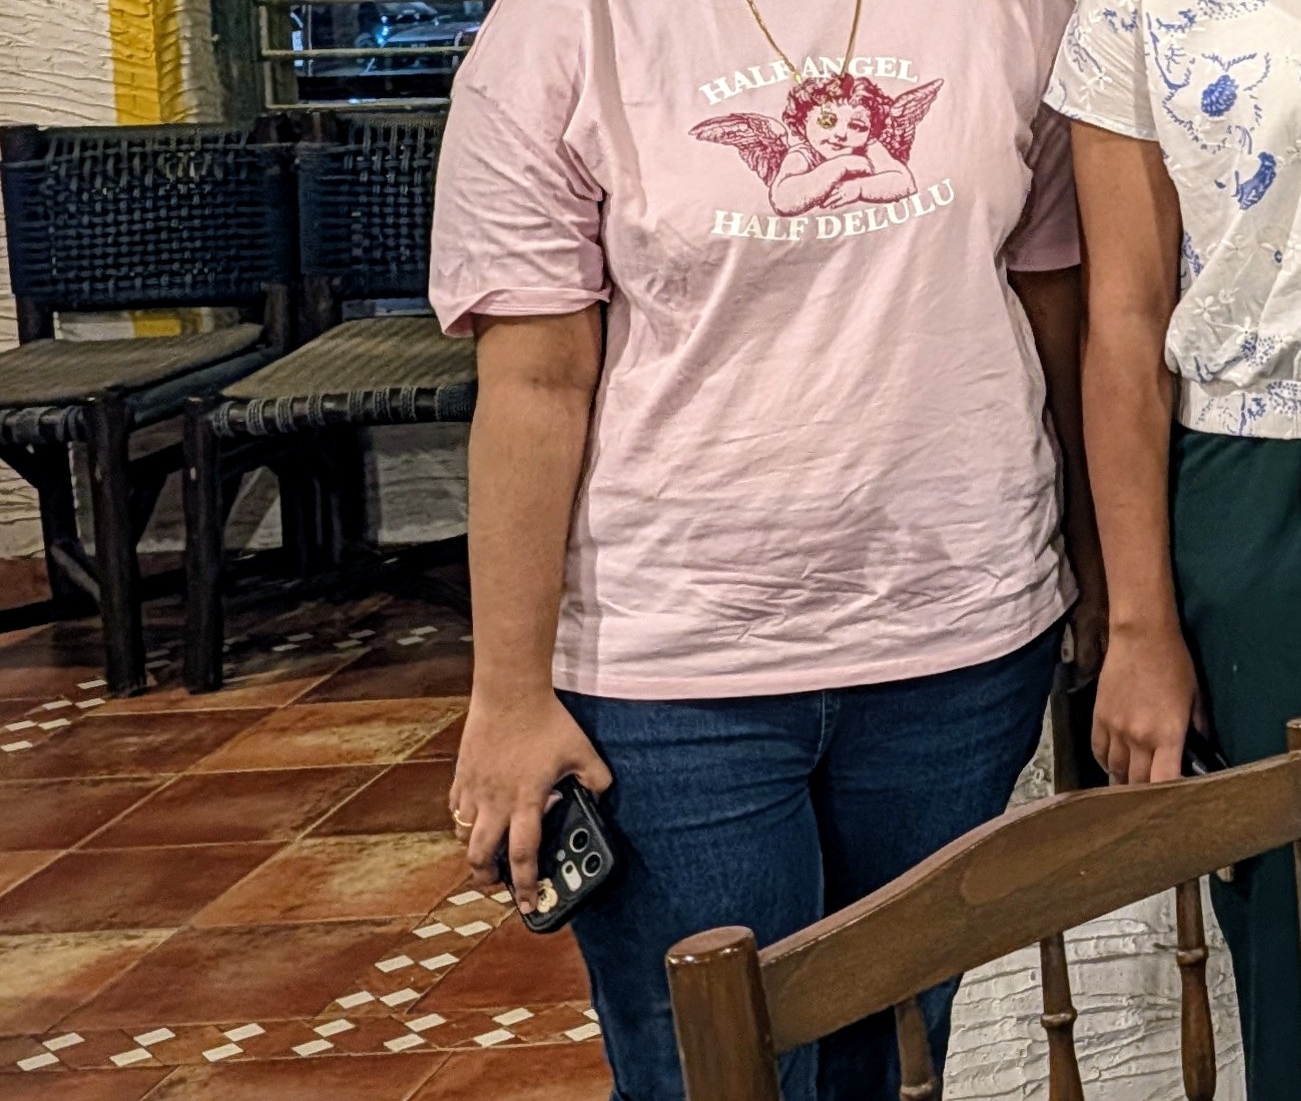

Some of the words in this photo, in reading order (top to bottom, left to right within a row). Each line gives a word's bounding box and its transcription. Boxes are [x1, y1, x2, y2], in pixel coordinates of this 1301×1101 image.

[699, 58, 795, 105] HALF
[801, 56, 919, 83] ANGEL
[710, 209, 811, 242] HALF
[815, 178, 955, 240] DELULU
